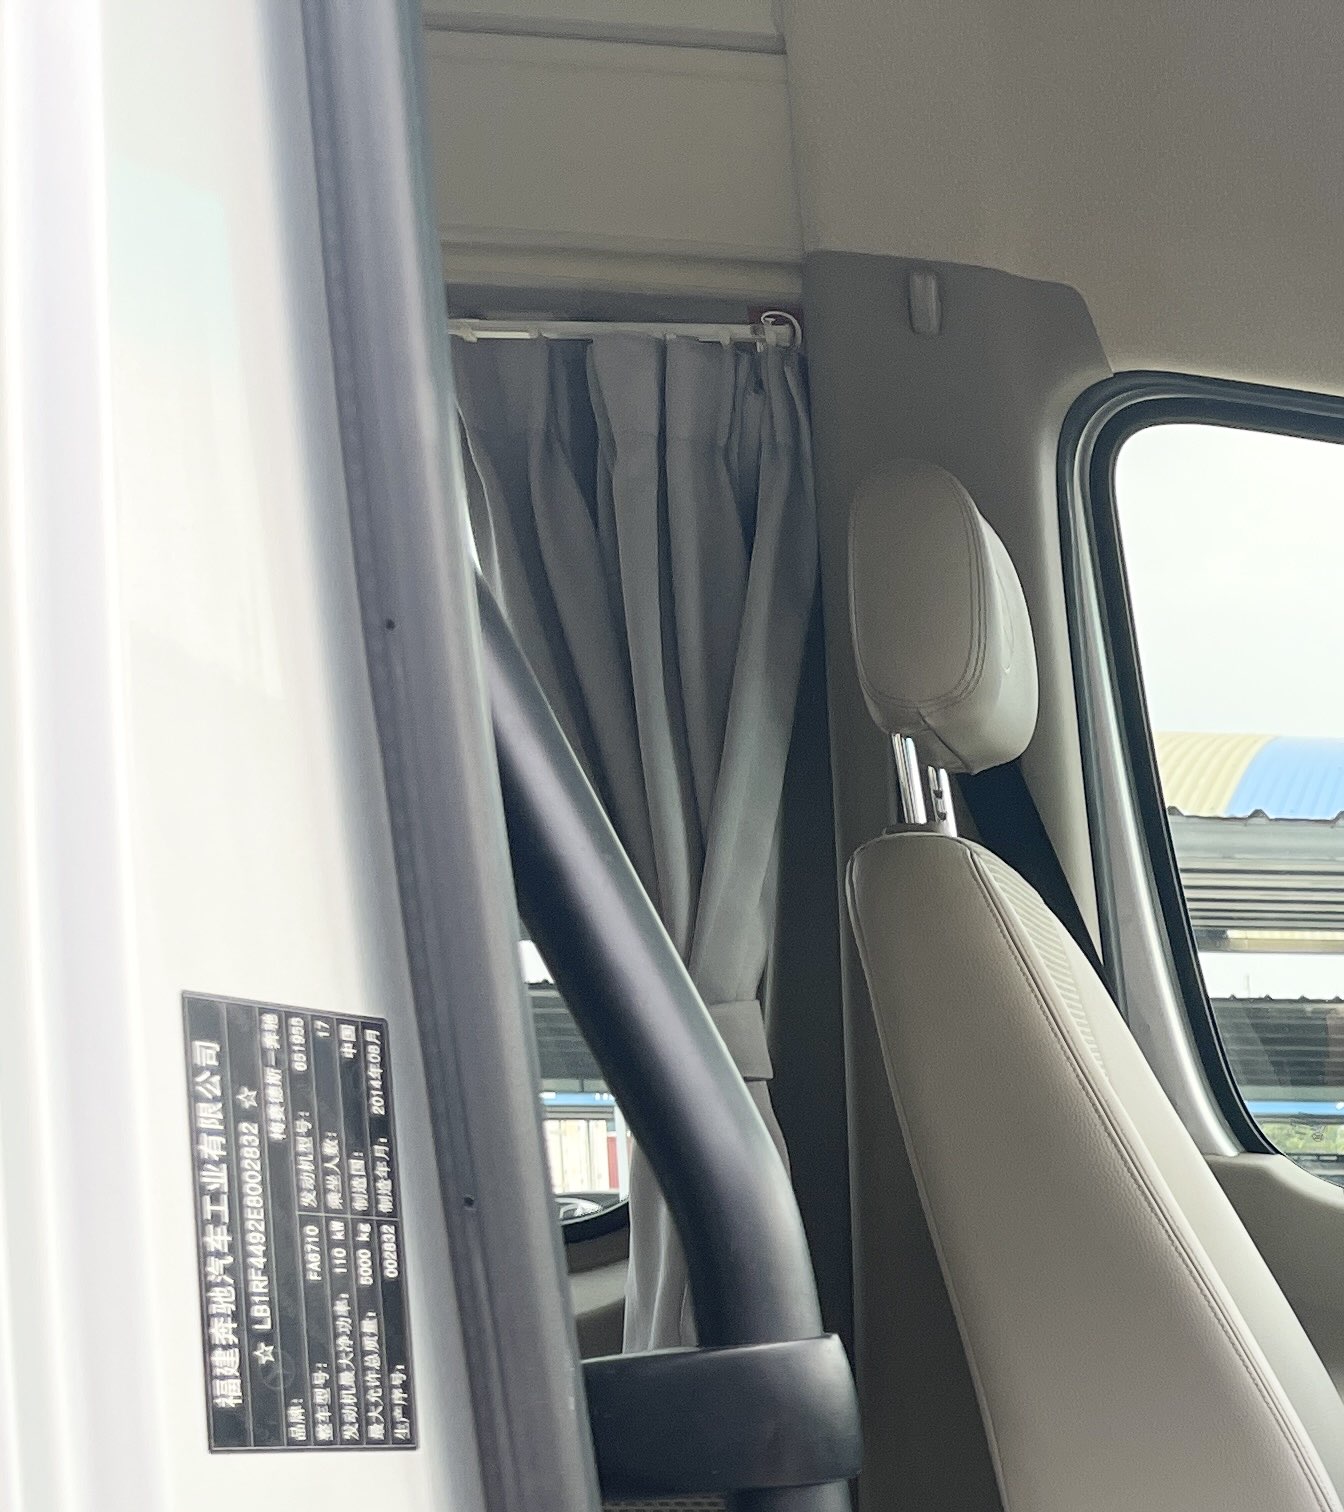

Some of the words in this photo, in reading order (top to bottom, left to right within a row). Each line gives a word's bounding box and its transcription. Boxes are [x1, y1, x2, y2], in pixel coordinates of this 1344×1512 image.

[314, 1020, 331, 1038] 17
[338, 1024, 359, 1060] 中国
[364, 1028, 387, 1116] 2014年08月
[191, 1040, 243, 1408] 福建奔驰汽车工业有限公司
[304, 1225, 322, 1281] FA6710
[331, 1247, 348, 1274] 110
[356, 1249, 374, 1286] 5000
[382, 1224, 400, 1279] 002832
